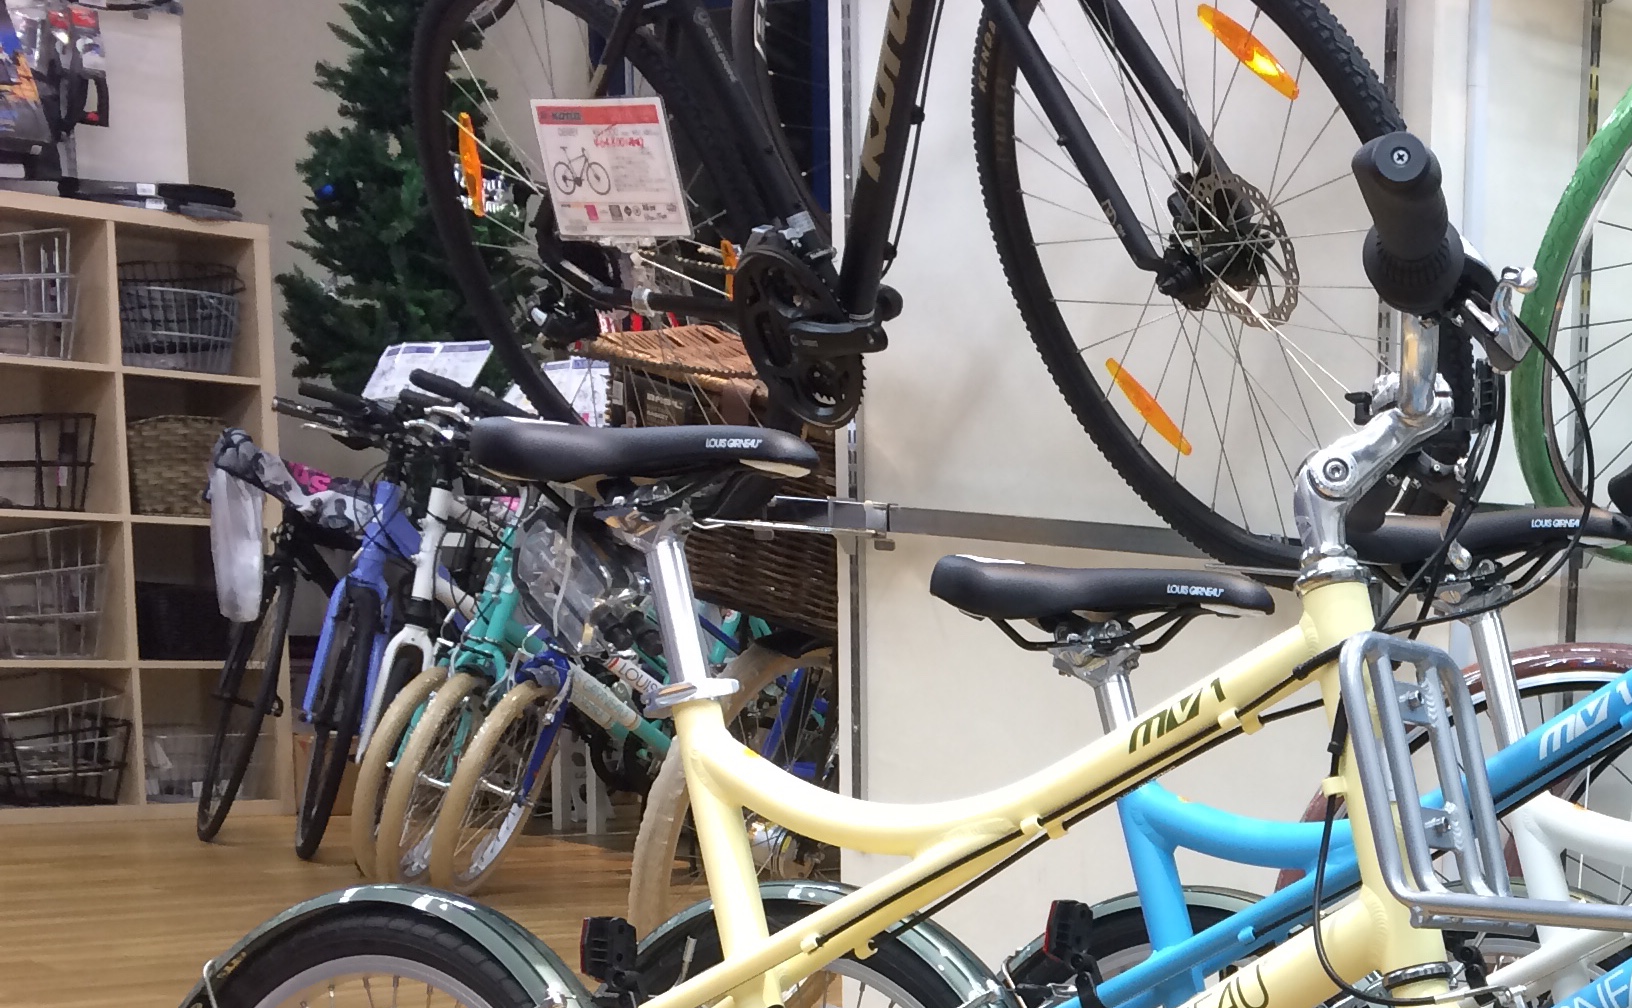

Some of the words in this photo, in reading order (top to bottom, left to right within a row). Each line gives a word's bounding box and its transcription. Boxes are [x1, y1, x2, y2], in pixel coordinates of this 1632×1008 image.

[705, 437, 727, 448] LOUIS
[727, 438, 762, 449] GARNEAU
[1531, 519, 1552, 528] LOUIS
[1552, 519, 1581, 529] GARNEA
[1166, 584, 1189, 595] LOUIS
[1189, 586, 1224, 597] GARNEAU
[617, 662, 659, 693] LOUIS
